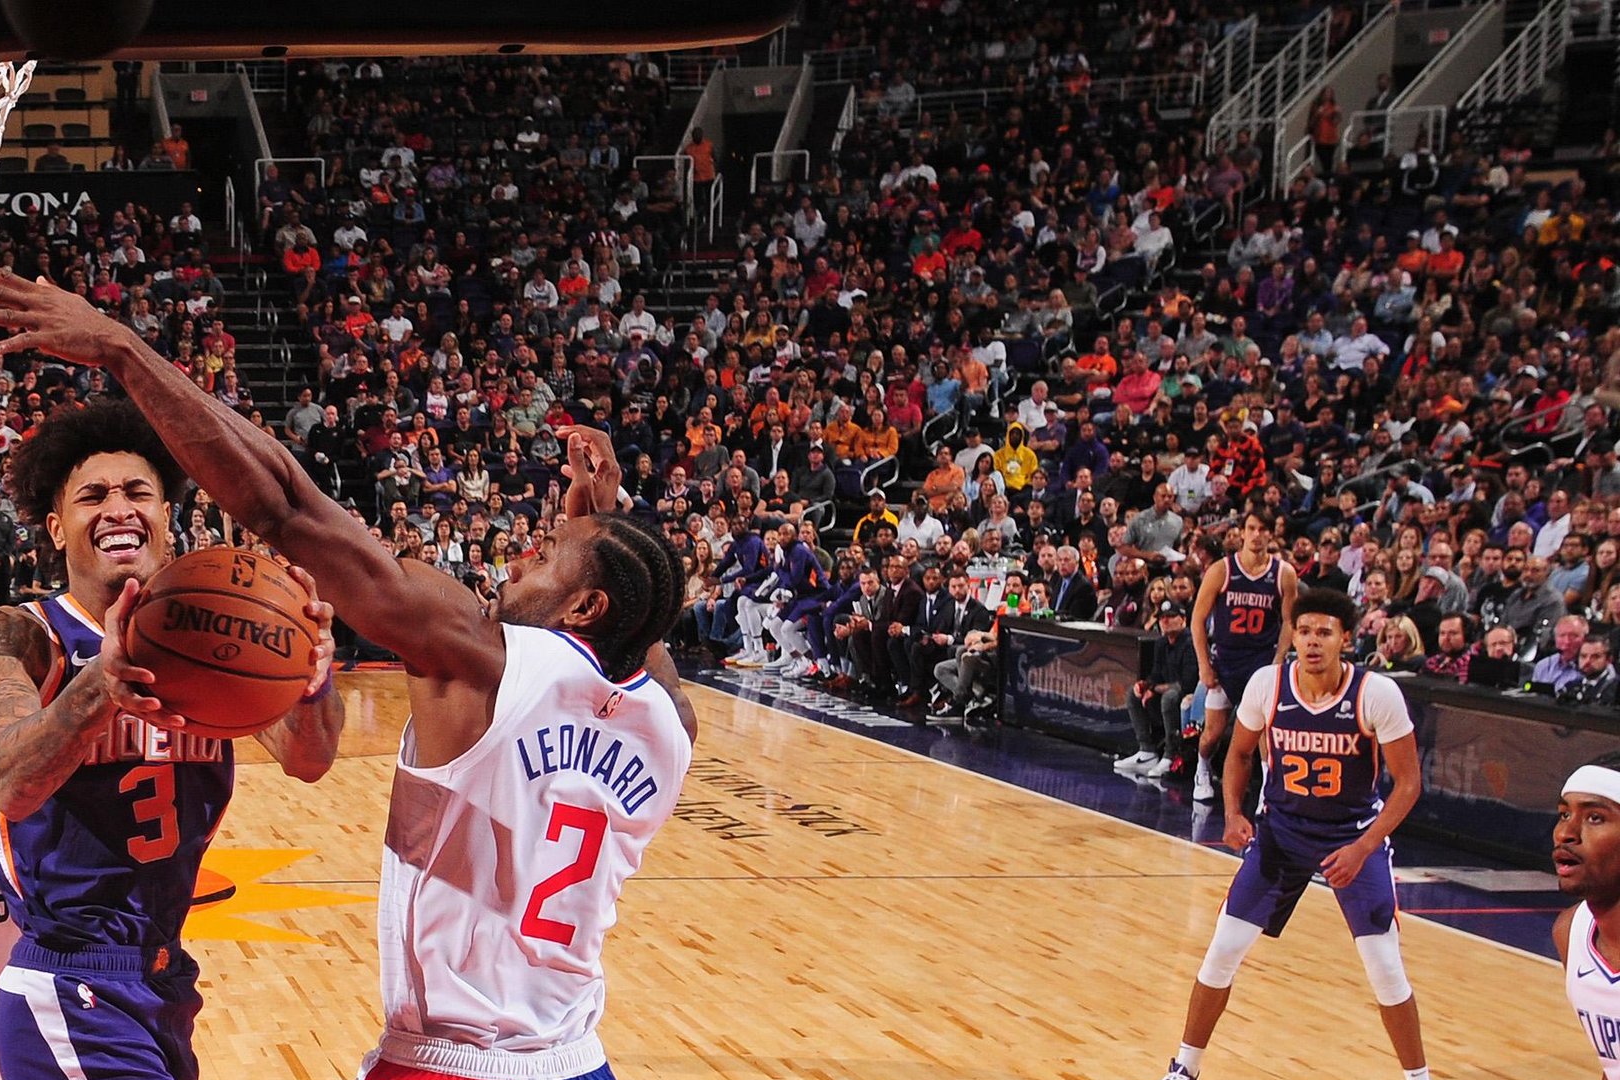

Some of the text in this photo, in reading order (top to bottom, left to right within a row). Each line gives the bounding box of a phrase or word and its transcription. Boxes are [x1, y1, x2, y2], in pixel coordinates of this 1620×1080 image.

[163, 600, 297, 659] SPALDING
[1226, 591, 1275, 609] PHOENIX
[1229, 607, 1265, 635] 20
[1017, 652, 1111, 713] Southwest
[517, 724, 658, 816] LEONARD
[1271, 727, 1361, 756] PHOENIX
[1281, 754, 1342, 798] 23
[119, 764, 180, 864] 3
[519, 801, 609, 946] 2
